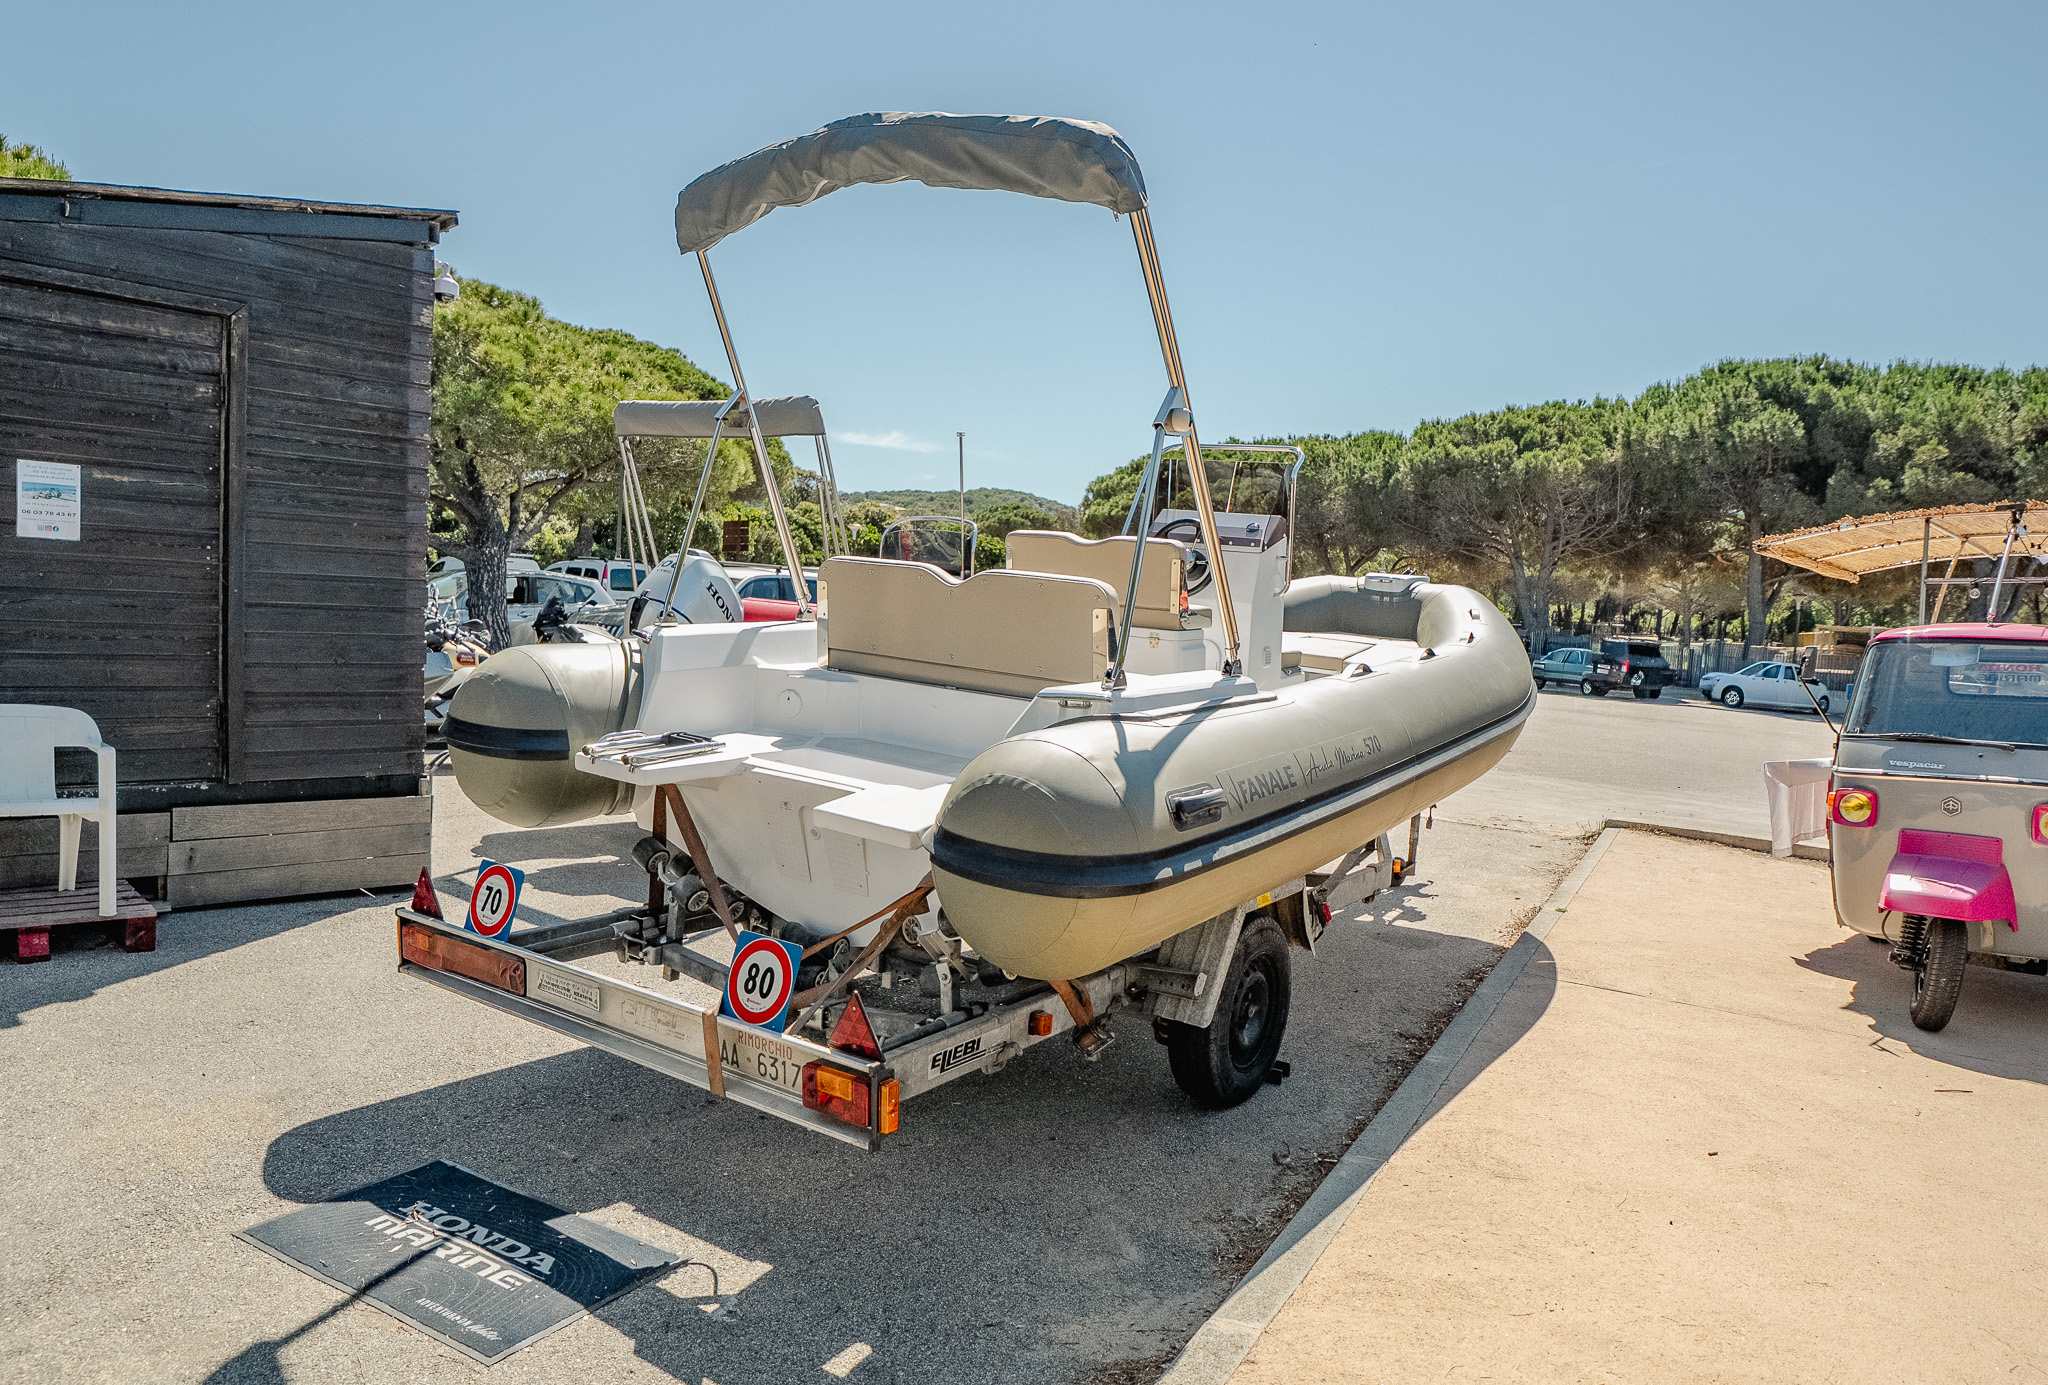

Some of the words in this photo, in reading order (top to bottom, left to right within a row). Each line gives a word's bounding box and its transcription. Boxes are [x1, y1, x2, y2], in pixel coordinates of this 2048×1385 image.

[706, 581, 736, 623] HON
[1237, 765, 1298, 804] FANALE
[1363, 735, 1383, 756] 570
[1888, 759, 1946, 770] vespacar
[481, 885, 502, 915] 70
[744, 962, 775, 999] 80
[720, 1039, 739, 1068] AA
[757, 1052, 801, 1088] 6317
[737, 1030, 793, 1060] RIMORCHIO
[931, 1036, 982, 1074] ELLEBI
[365, 1214, 533, 1291] MARINE
[398, 1200, 556, 1275] HONDA
